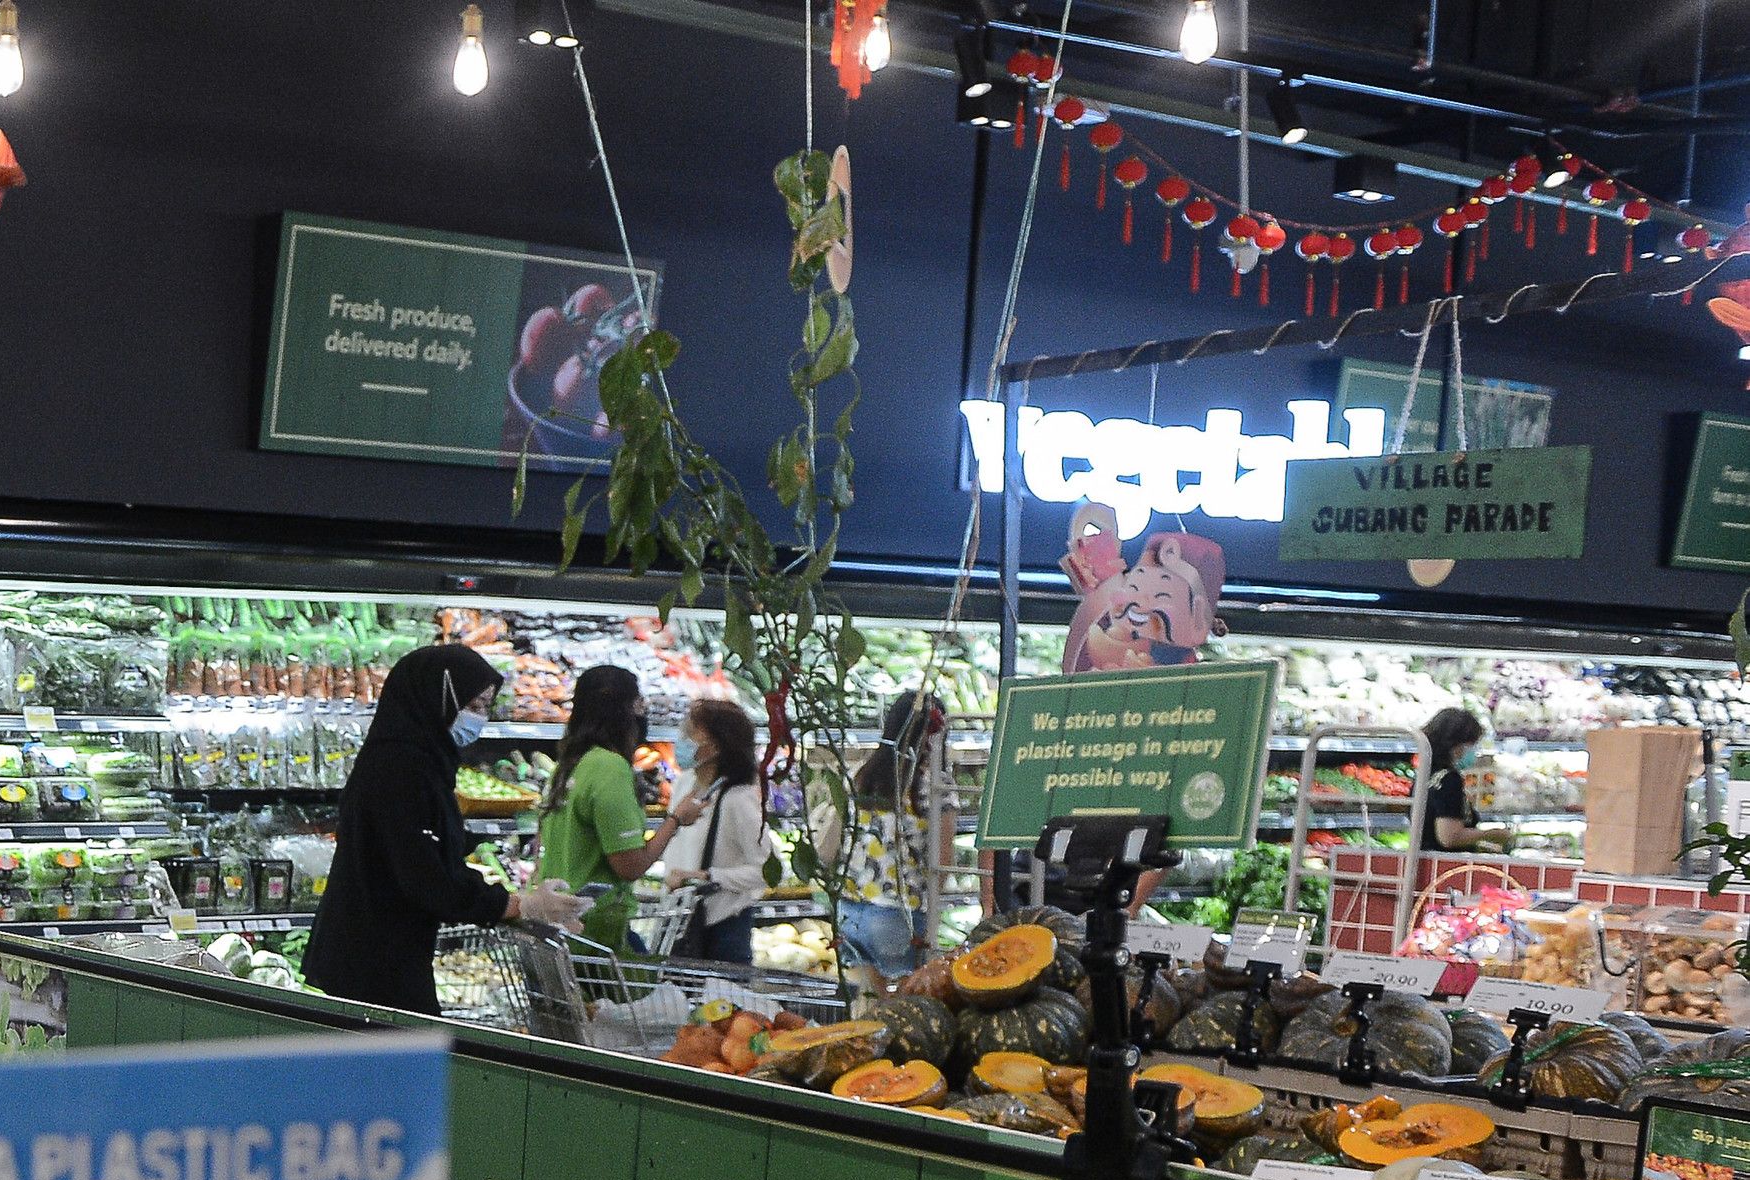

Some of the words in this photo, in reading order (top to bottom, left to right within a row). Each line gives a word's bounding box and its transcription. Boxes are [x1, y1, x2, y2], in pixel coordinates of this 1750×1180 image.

[329, 293, 385, 322] Fresh
[390, 305, 477, 338] produce,
[325, 328, 419, 360] delivered
[423, 339, 473, 372] daily.
[1353, 462, 1493, 491] VILLAGE
[1312, 503, 1429, 535] SUBANG
[1445, 501, 1555, 534] PARADE
[1032, 711, 1059, 732] We
[1064, 711, 1117, 730] strive
[1122, 710, 1143, 728] to
[1150, 706, 1217, 727] reduce
[1015, 741, 1075, 764] plastic
[1080, 741, 1138, 762] usage
[1143, 737, 1163, 756] in
[1167, 738, 1227, 760] every
[1044, 767, 1125, 792] possible
[1129, 769, 1172, 791] way.
[1526, 999, 1574, 1014] 19.90
[1692, 1129, 1714, 1145] Skip
[1716, 1136, 1723, 1144] a
